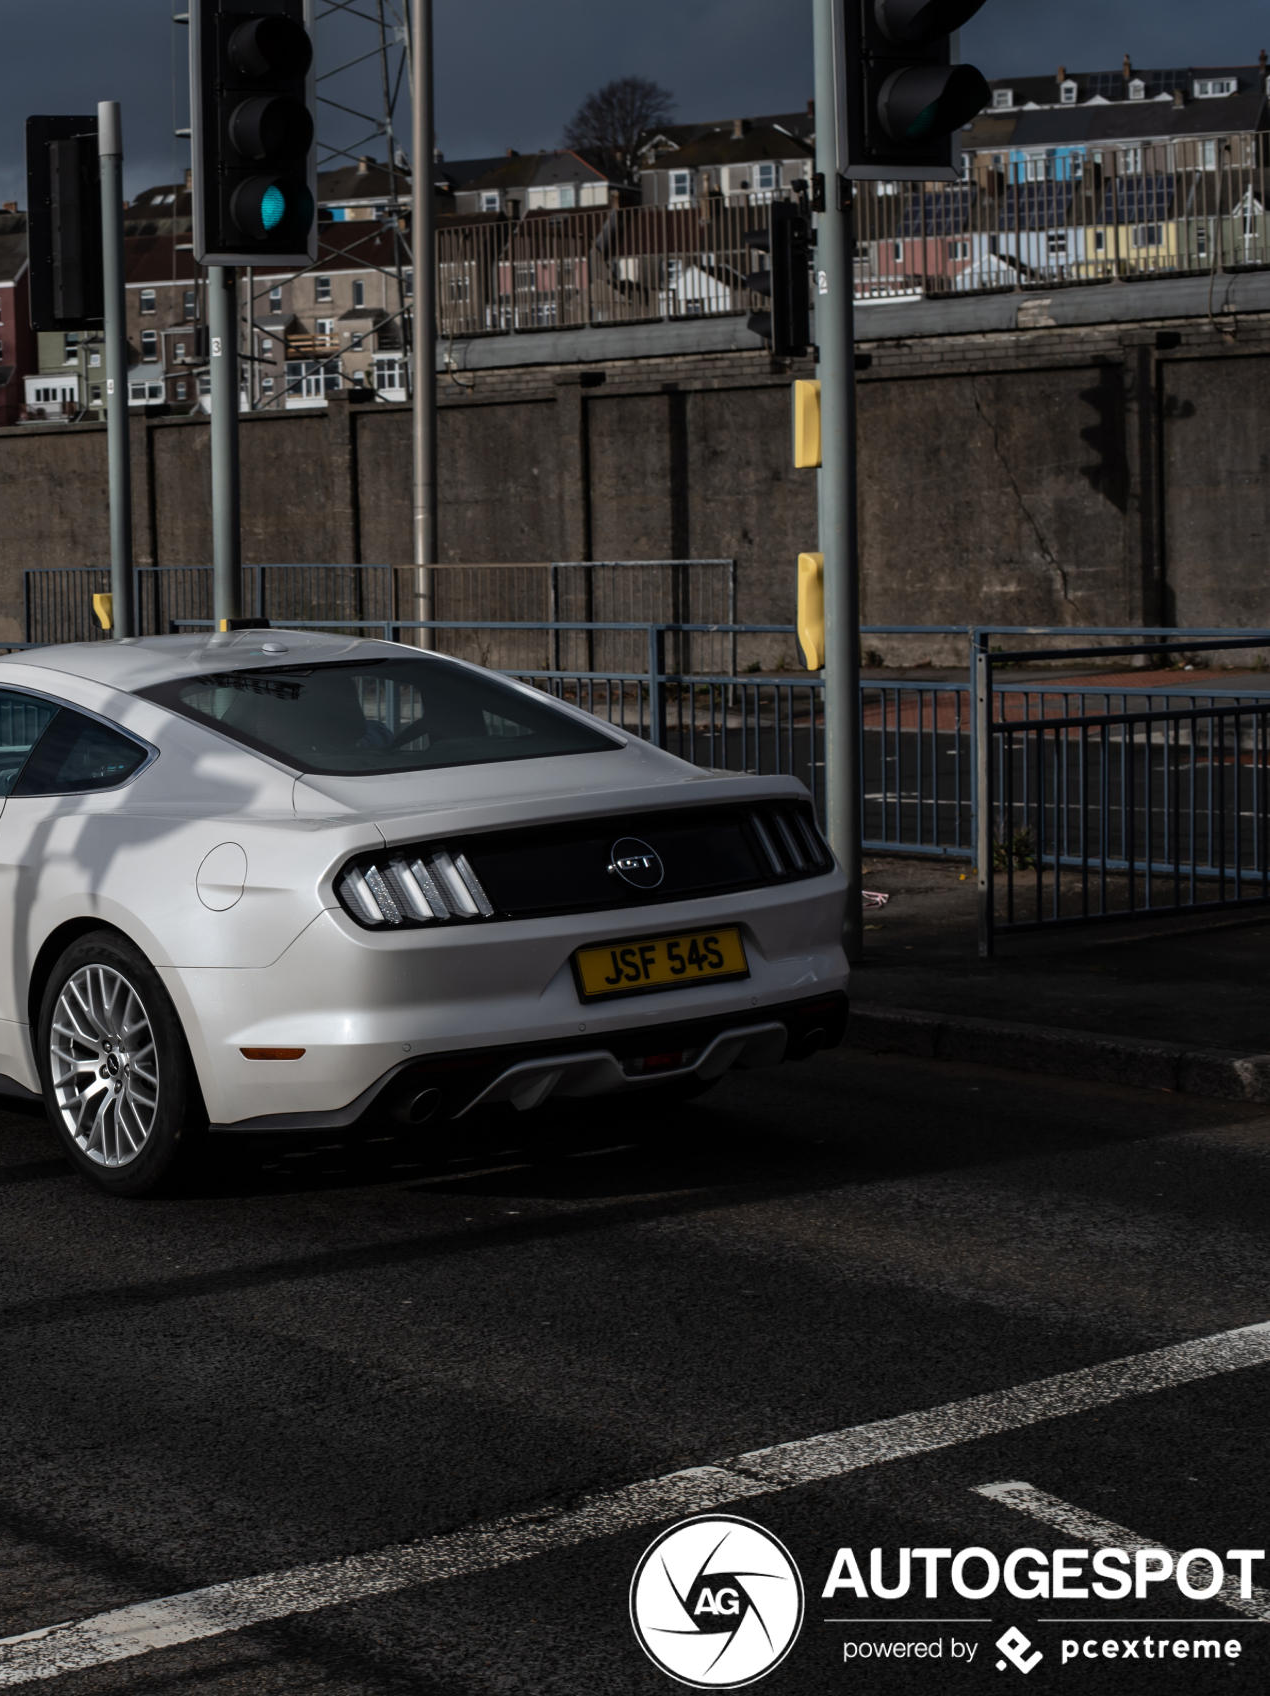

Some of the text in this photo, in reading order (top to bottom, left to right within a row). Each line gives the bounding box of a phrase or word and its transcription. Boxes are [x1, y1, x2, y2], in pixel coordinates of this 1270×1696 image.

[213, 341, 221, 353] 3
[617, 854, 654, 870] GT
[604, 936, 724, 985] JSF 54S
